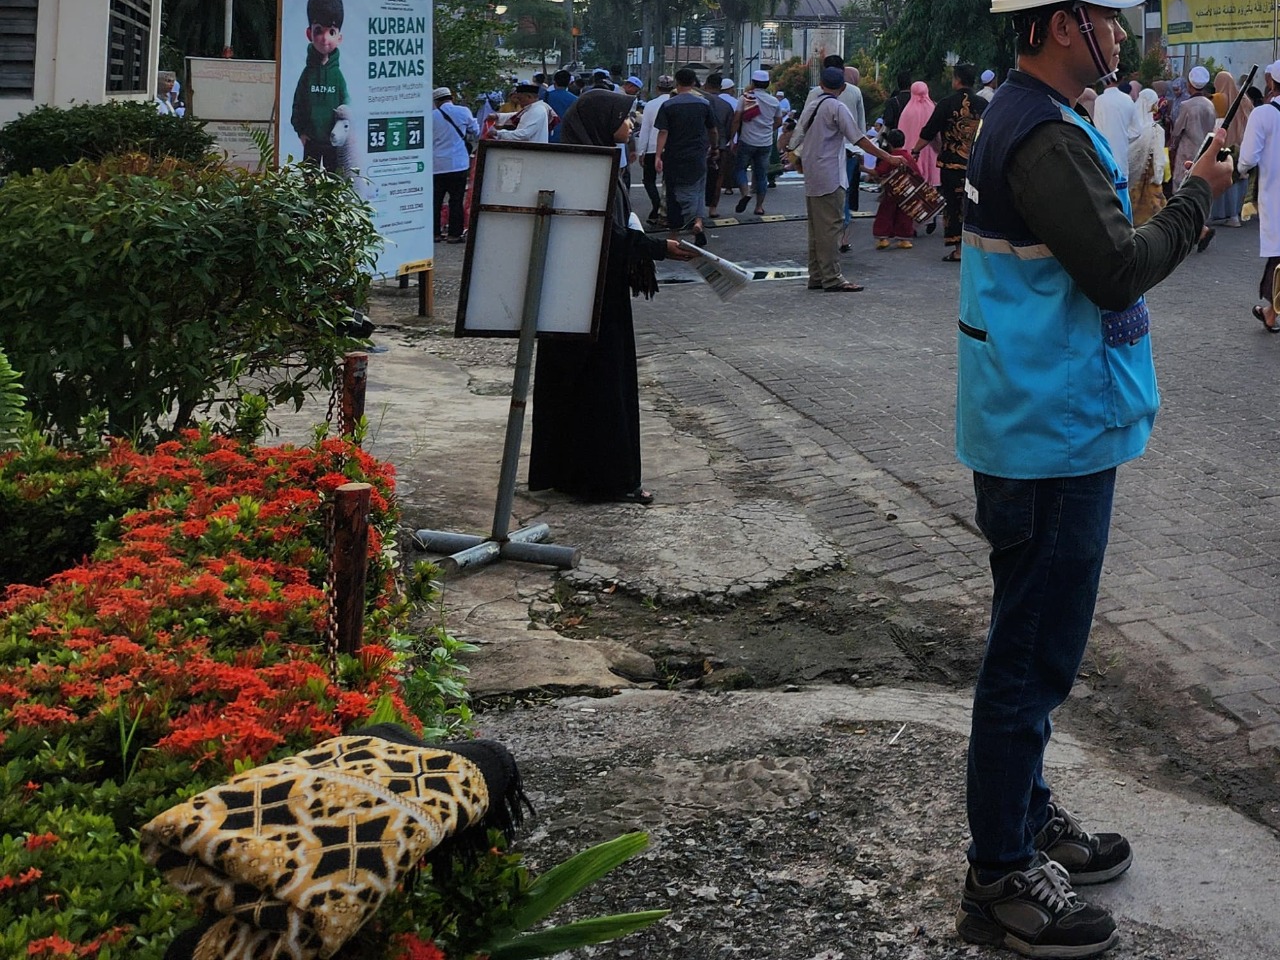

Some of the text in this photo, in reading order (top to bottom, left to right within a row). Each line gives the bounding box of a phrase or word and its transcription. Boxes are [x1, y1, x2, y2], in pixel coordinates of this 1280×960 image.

[368, 17, 425, 34] KURBAN
[368, 38, 424, 57] BERKAH
[368, 59, 425, 79] BAZNAS
[392, 131, 400, 146] 3
[409, 130, 420, 144] 21
